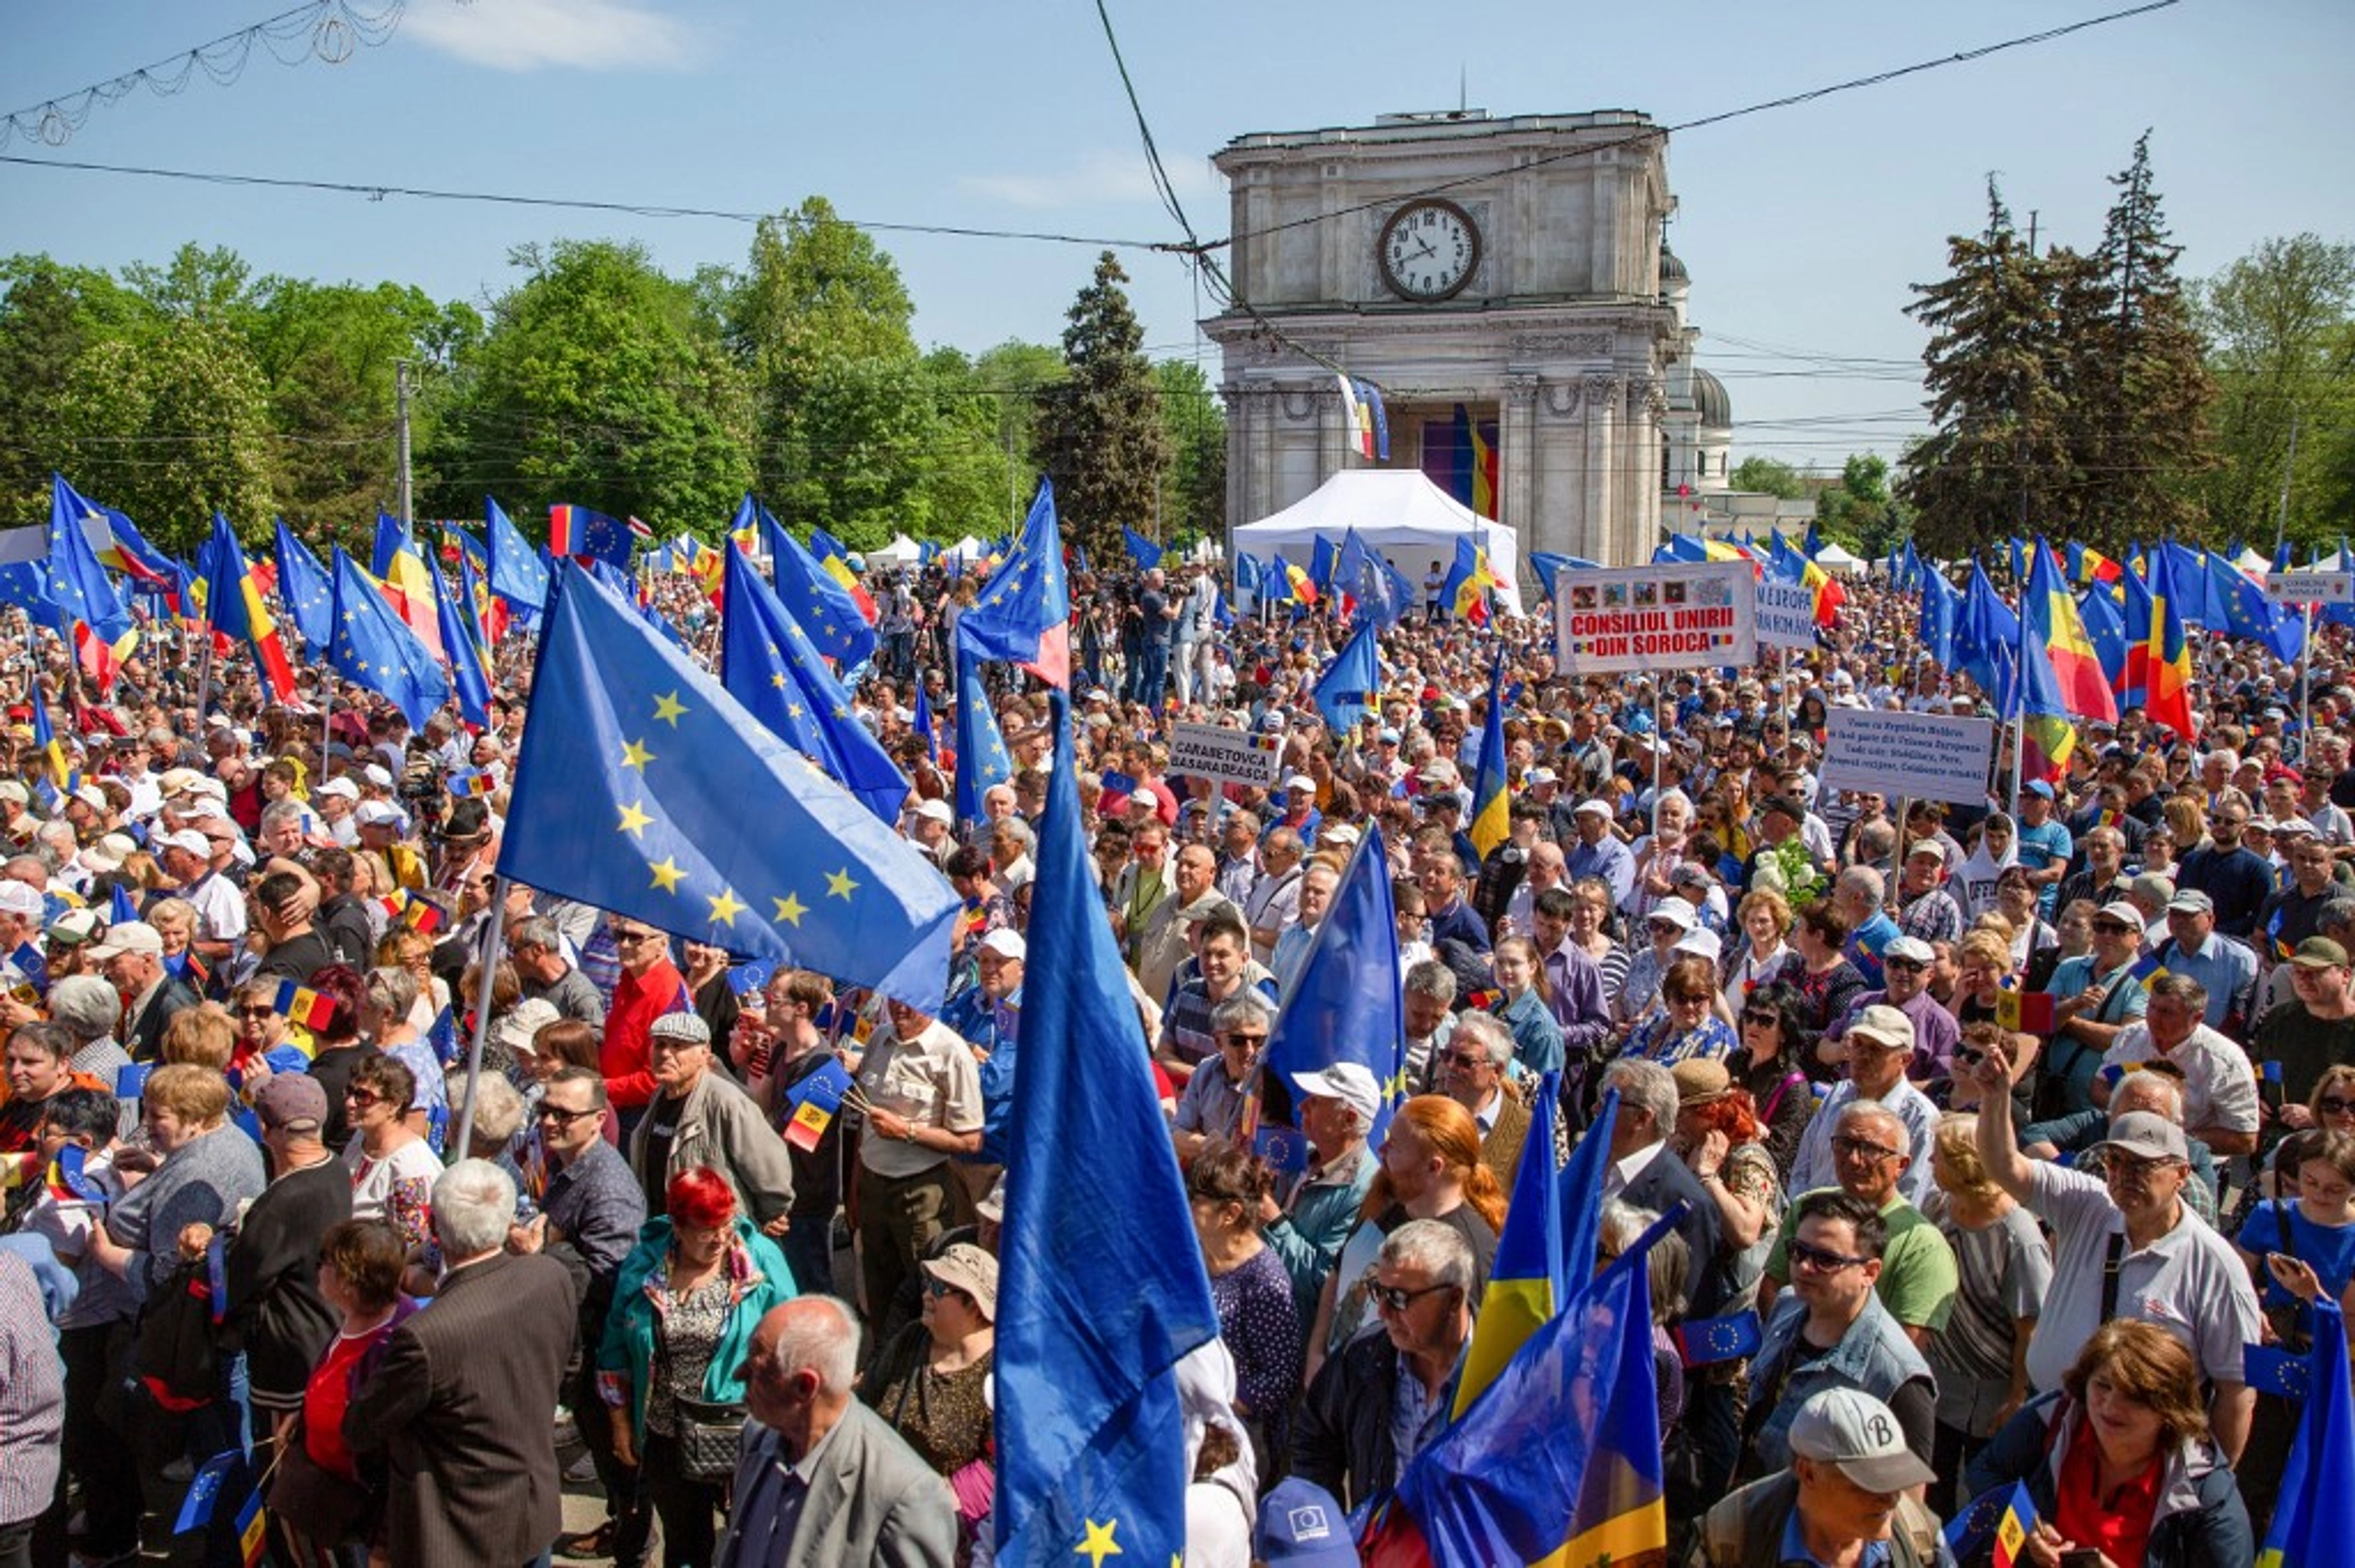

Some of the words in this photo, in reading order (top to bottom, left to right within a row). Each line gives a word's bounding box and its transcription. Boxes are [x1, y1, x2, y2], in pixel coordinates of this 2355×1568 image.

[1409, 217, 1418, 231] 11
[1424, 212, 1435, 226] 12
[1442, 216, 1447, 230] 1
[1396, 228, 1408, 242] 10
[1452, 227, 1459, 240] 2
[1394, 246, 1401, 258] 9
[1456, 244, 1464, 257] 3
[1408, 272, 1416, 286] 7
[1424, 276, 1431, 288] 6
[1441, 271, 1448, 285] 5
[1571, 611, 1669, 635] CONSILIUL
[1673, 607, 1734, 629] UNIRII
[1595, 637, 1628, 657] DIN
[1632, 633, 1711, 655] SOROCA
[1867, 1413, 1893, 1447] B
